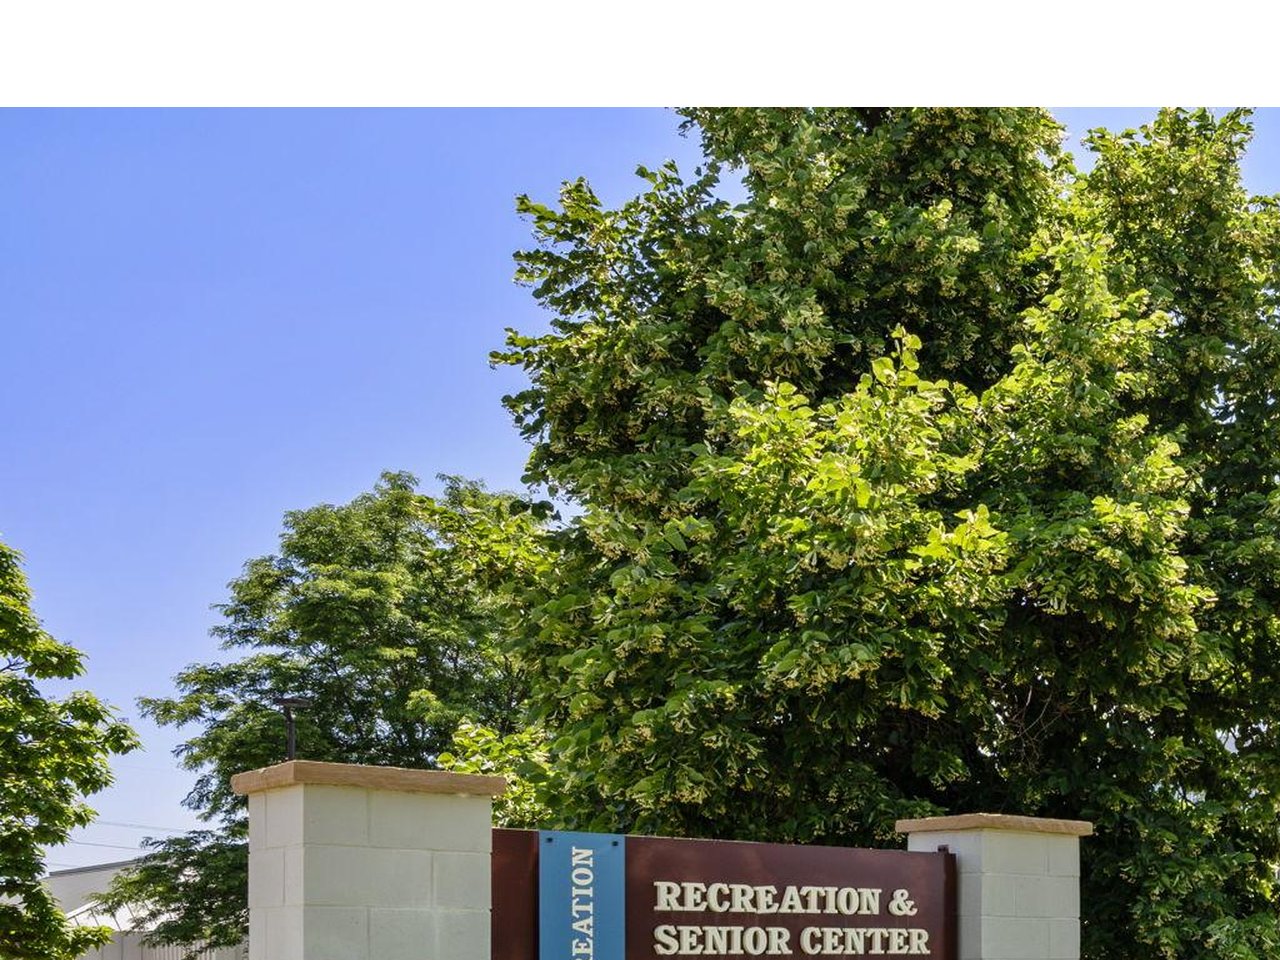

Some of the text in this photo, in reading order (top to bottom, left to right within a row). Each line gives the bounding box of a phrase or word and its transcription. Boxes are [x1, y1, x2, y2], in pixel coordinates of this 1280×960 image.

[653, 881, 918, 917] RECREATION &
[653, 925, 931, 956] SENIOR CENTER
